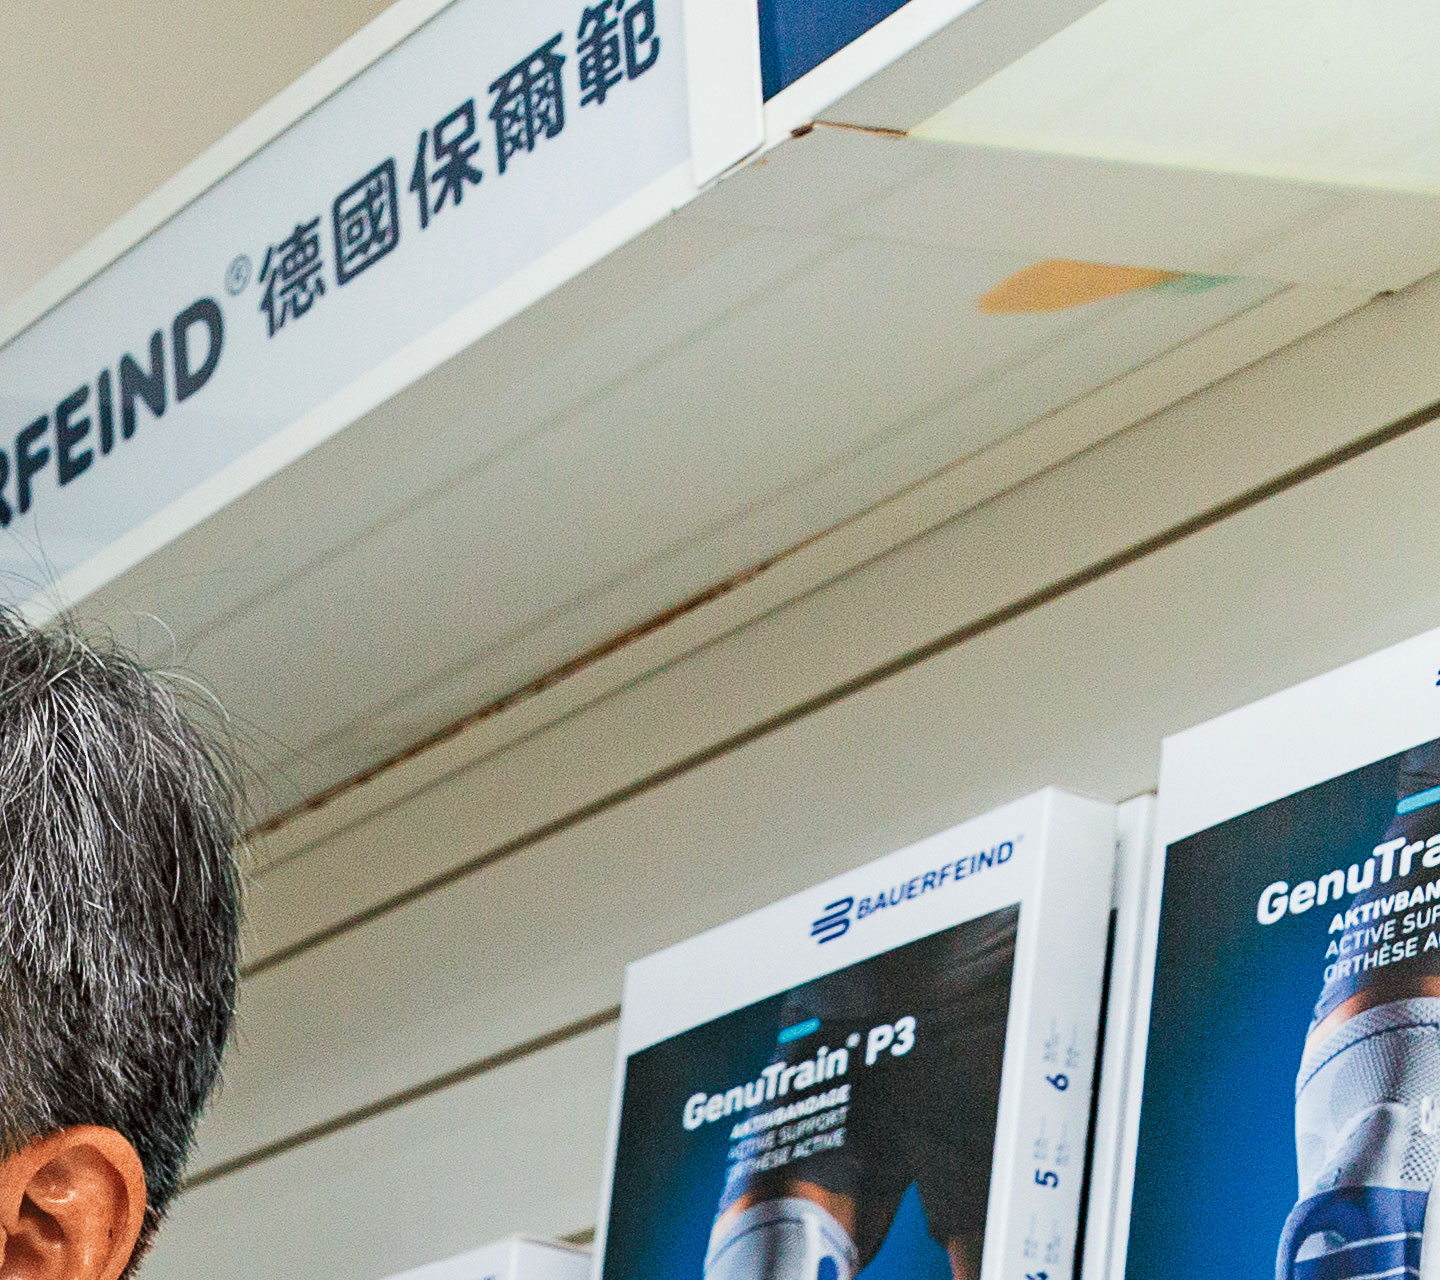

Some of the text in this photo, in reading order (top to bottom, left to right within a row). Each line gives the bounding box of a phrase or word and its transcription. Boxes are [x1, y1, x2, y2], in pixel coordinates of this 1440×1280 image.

[259, 0, 663, 337] 德國保爾範
[1323, 936, 1419, 984] ORTHÈSE
[1325, 919, 1396, 959] ACTIVE
[865, 1015, 916, 1066] P3
[1046, 1072, 1069, 1092] 6
[1035, 1169, 1058, 1188] 5
